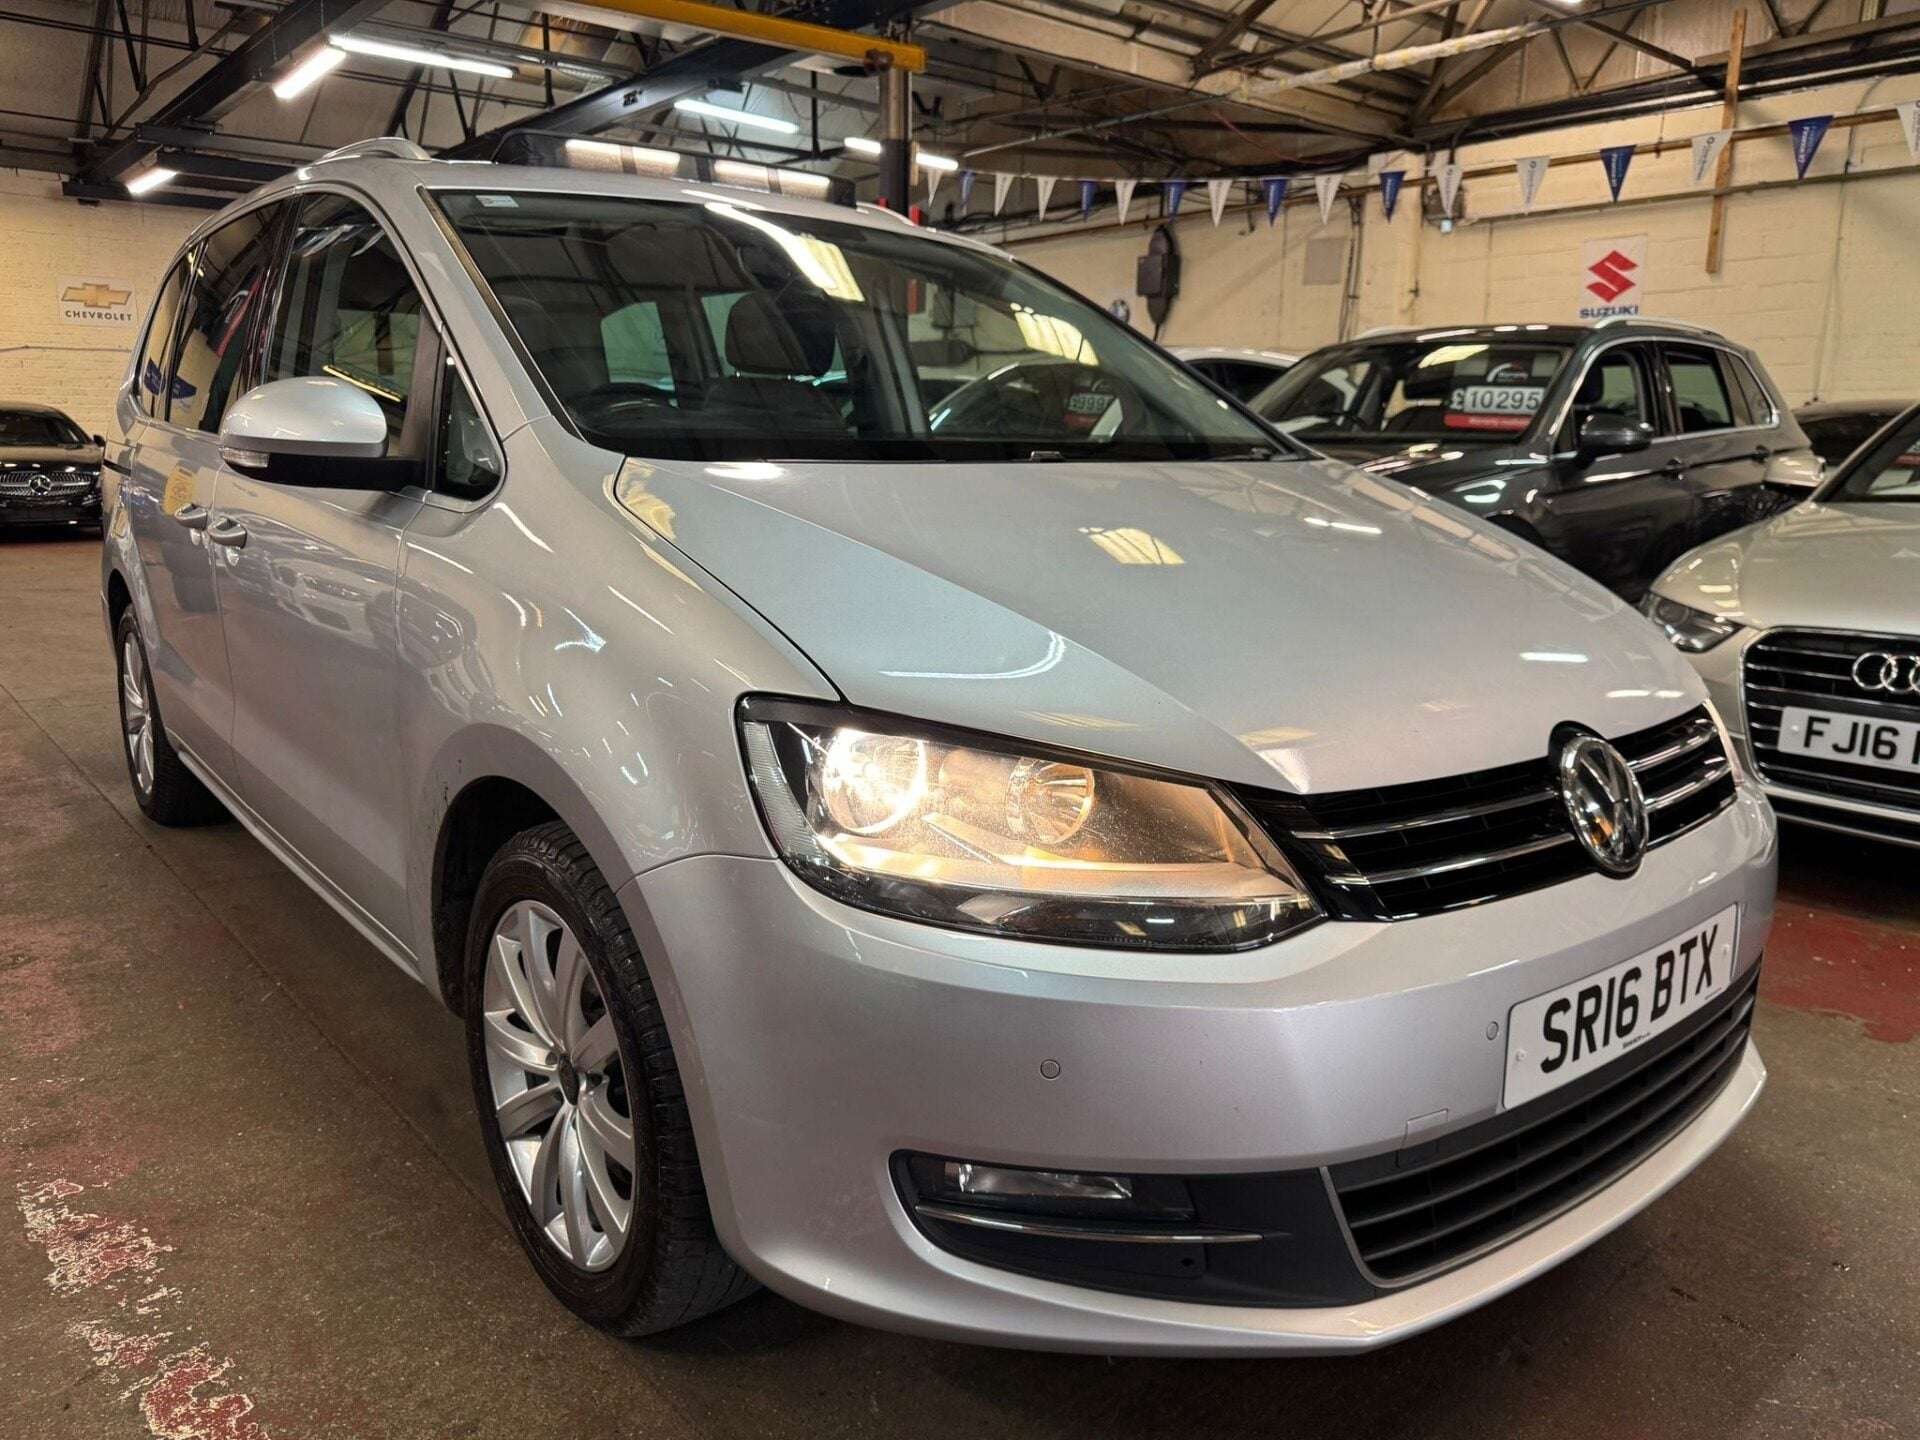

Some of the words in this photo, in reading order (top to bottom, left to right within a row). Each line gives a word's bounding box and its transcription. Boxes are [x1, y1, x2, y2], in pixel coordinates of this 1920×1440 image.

[65, 310, 132, 321] CHEVROLET
[1579, 304, 1639, 318] SUZUKI
[1449, 387, 1540, 410] £10295
[1803, 715, 1901, 761] FJ16
[1540, 966, 1642, 1074] SR16
[1650, 923, 1719, 1023] BTX
